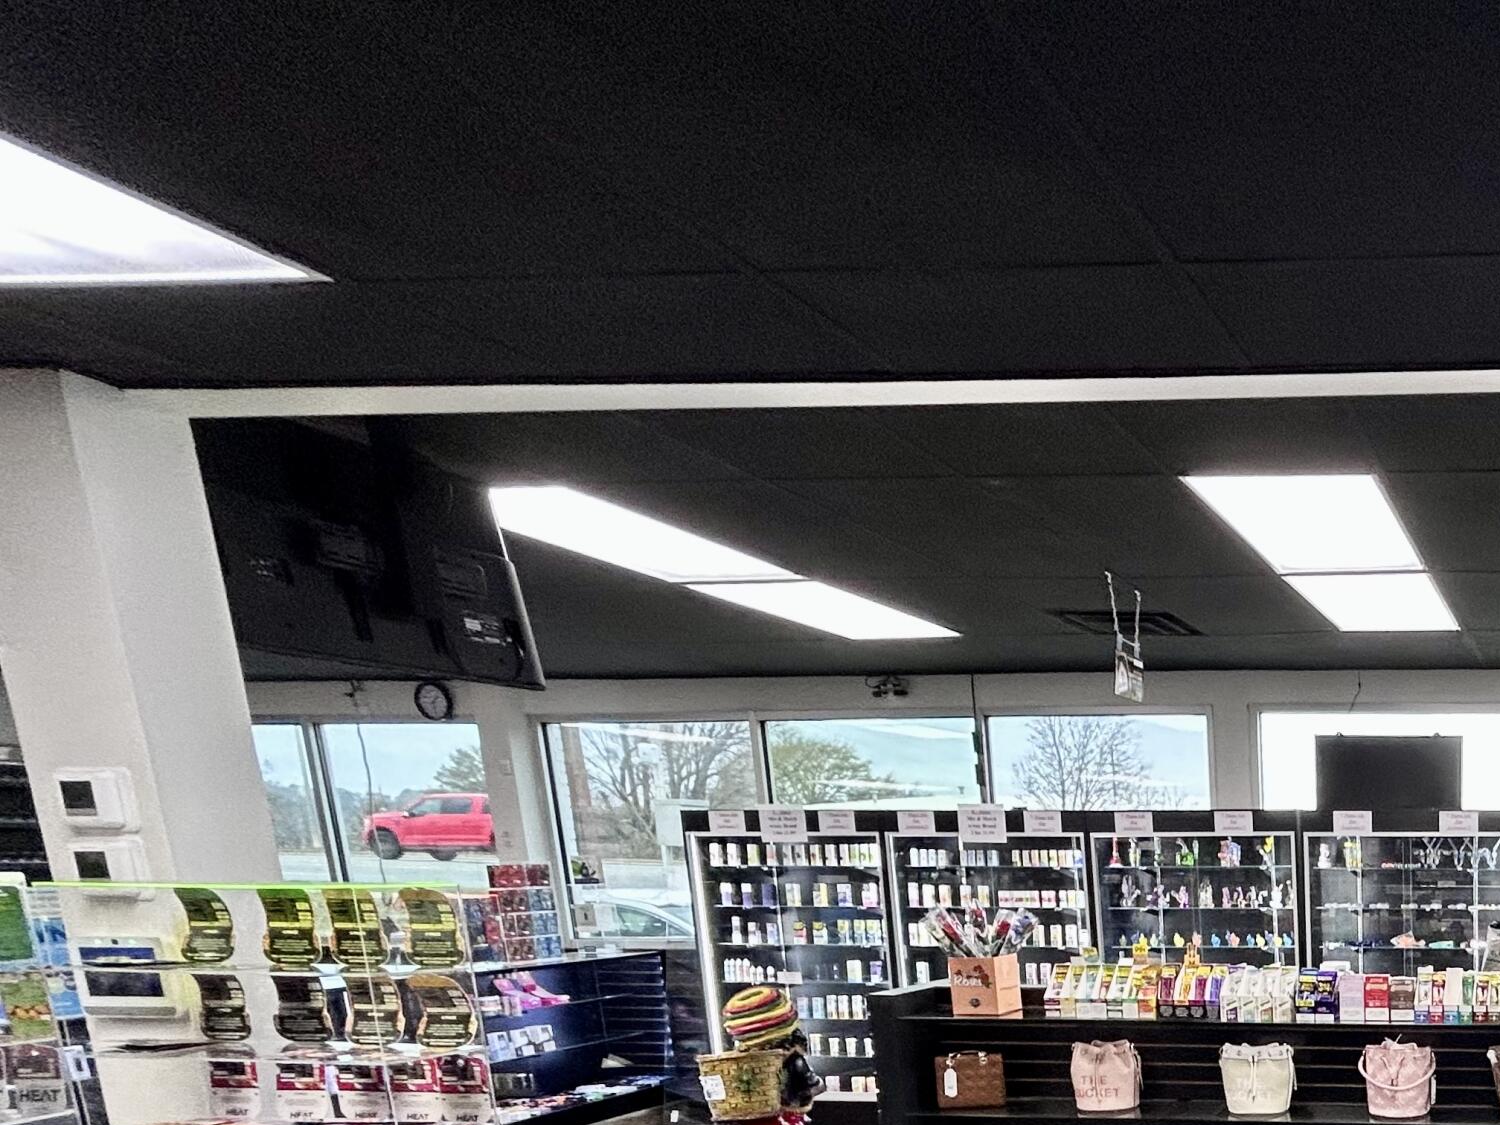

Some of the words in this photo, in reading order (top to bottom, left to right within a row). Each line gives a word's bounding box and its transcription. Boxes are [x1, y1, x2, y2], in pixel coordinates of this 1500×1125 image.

[20, 1089, 60, 1102] HEAT
[225, 1108, 249, 1116] HEAT
[290, 1111, 314, 1119] HEAT
[456, 1114, 478, 1122] HEAT
